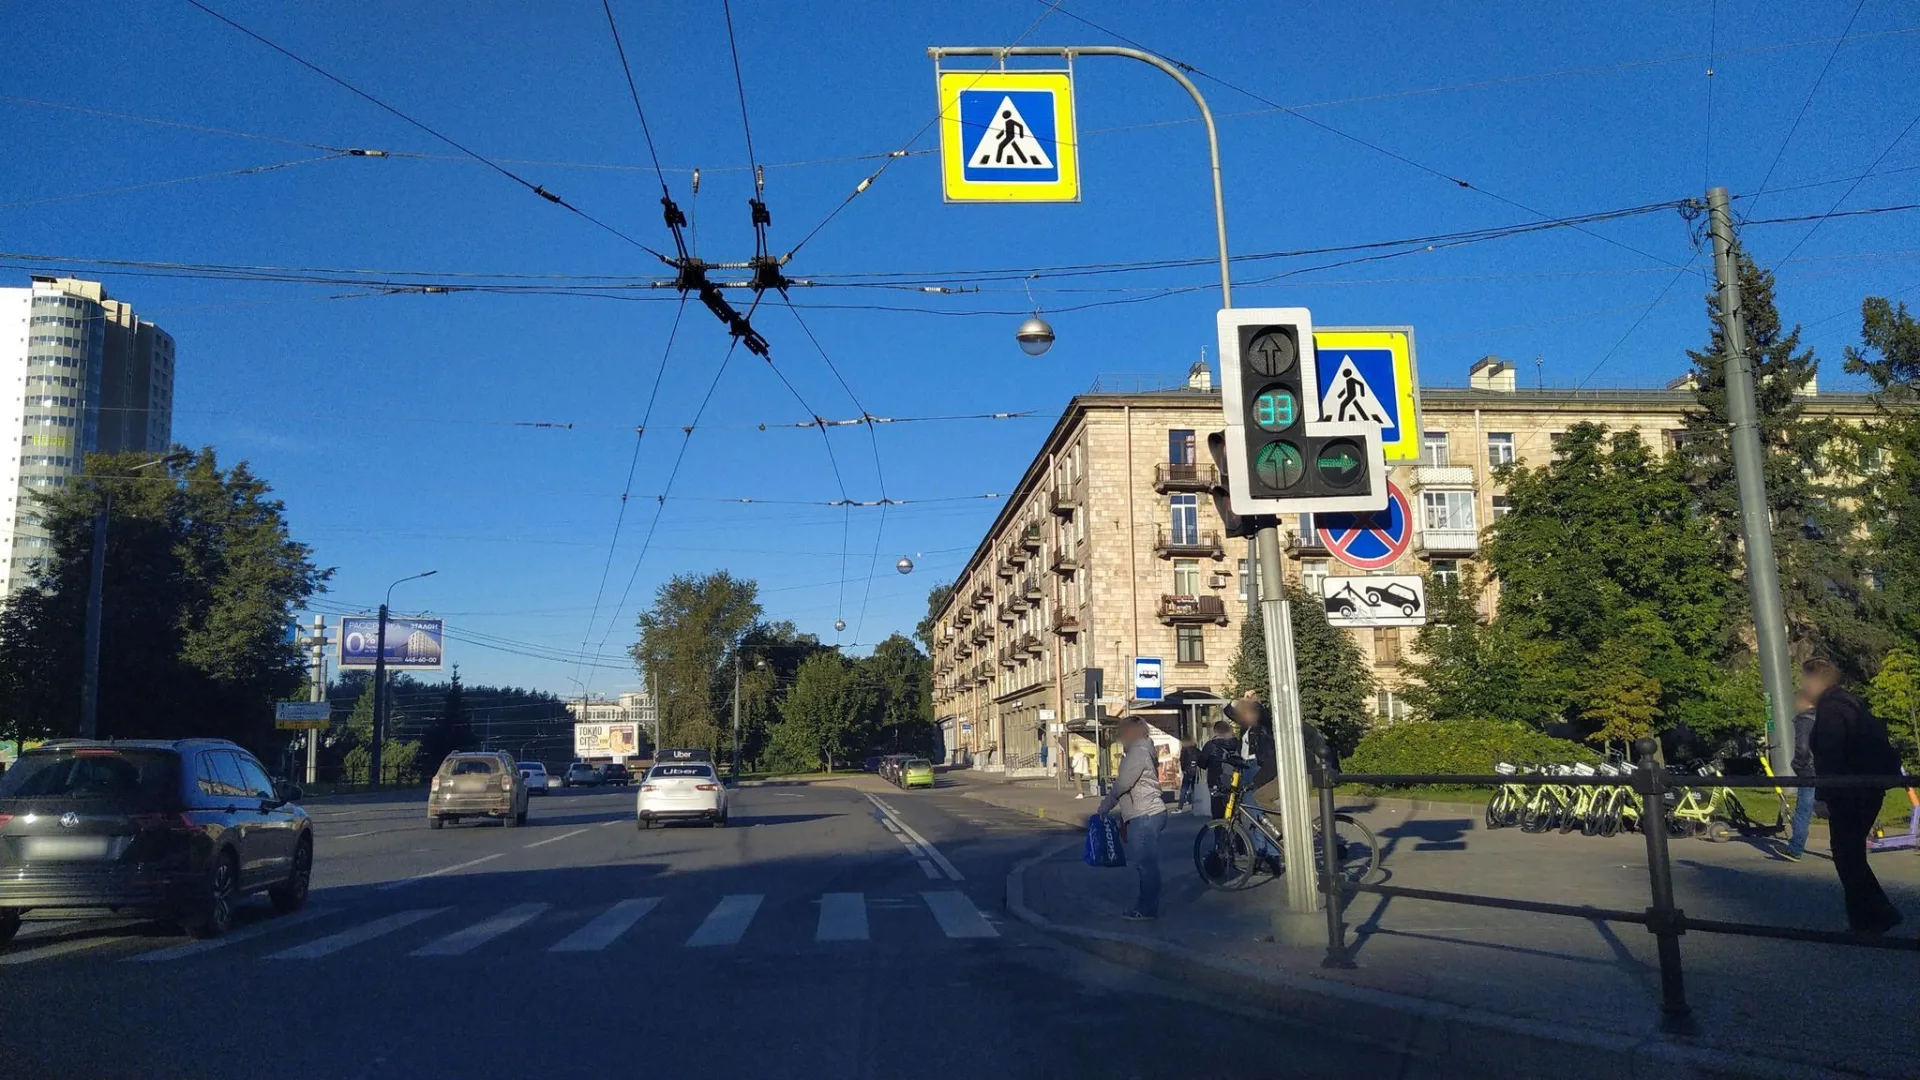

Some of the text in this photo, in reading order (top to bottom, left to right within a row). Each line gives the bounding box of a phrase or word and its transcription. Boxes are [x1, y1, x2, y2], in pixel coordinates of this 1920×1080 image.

[1259, 394, 1292, 425] 33
[348, 621, 401, 630] РАССРКА
[411, 622, 438, 630] ЭТАЛОН
[673, 750, 692, 758] Uber
